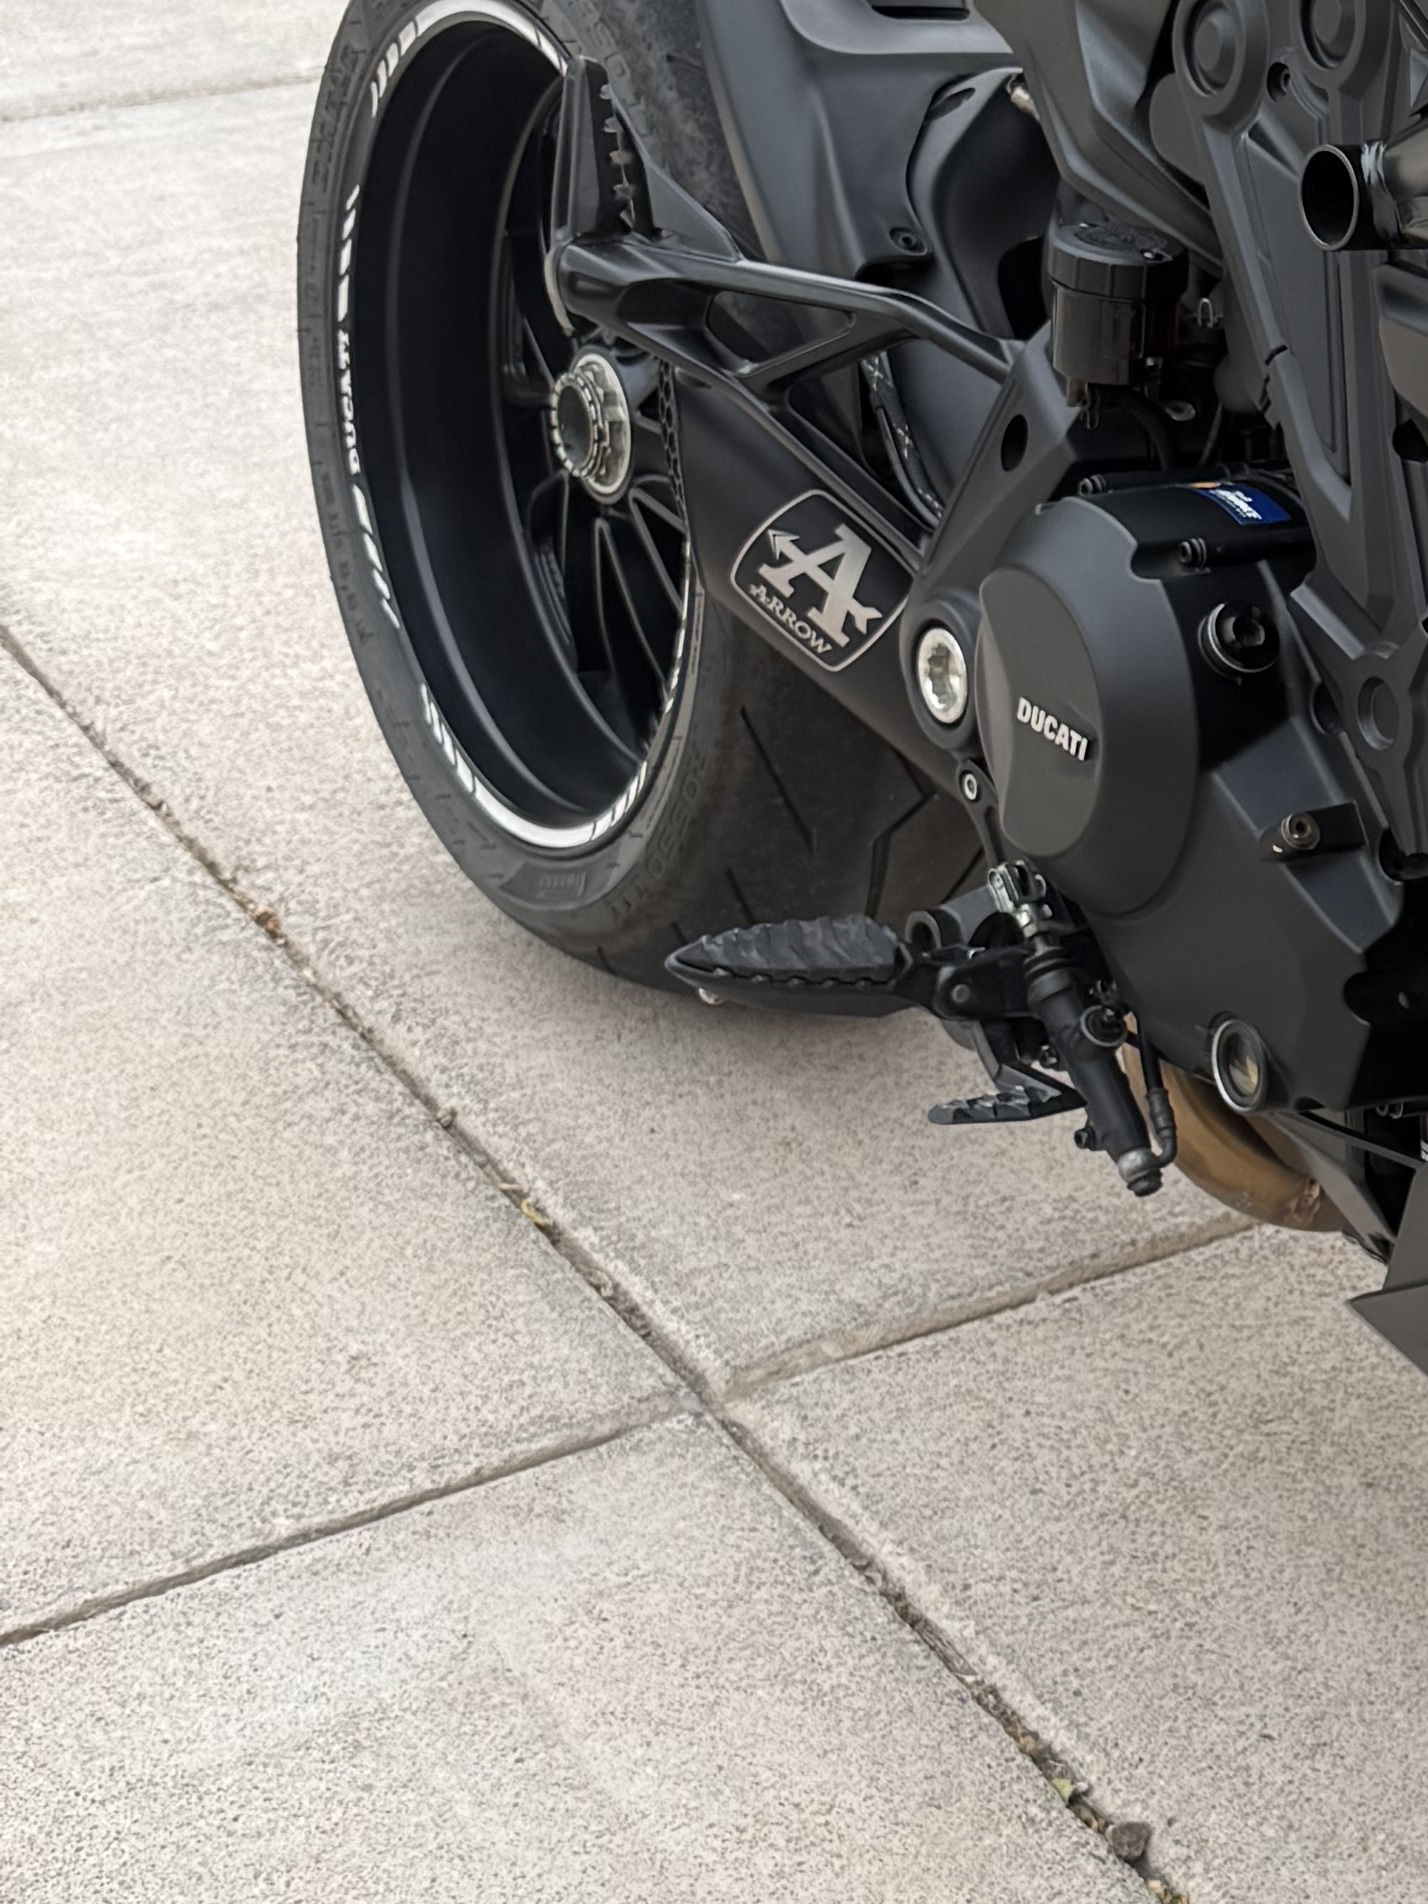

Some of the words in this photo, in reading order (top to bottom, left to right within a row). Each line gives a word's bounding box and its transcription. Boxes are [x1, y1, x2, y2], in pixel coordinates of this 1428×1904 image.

[335, 332, 362, 477] DUCATI
[750, 583, 832, 657] ARROW
[1016, 697, 1090, 763] DUCATI
